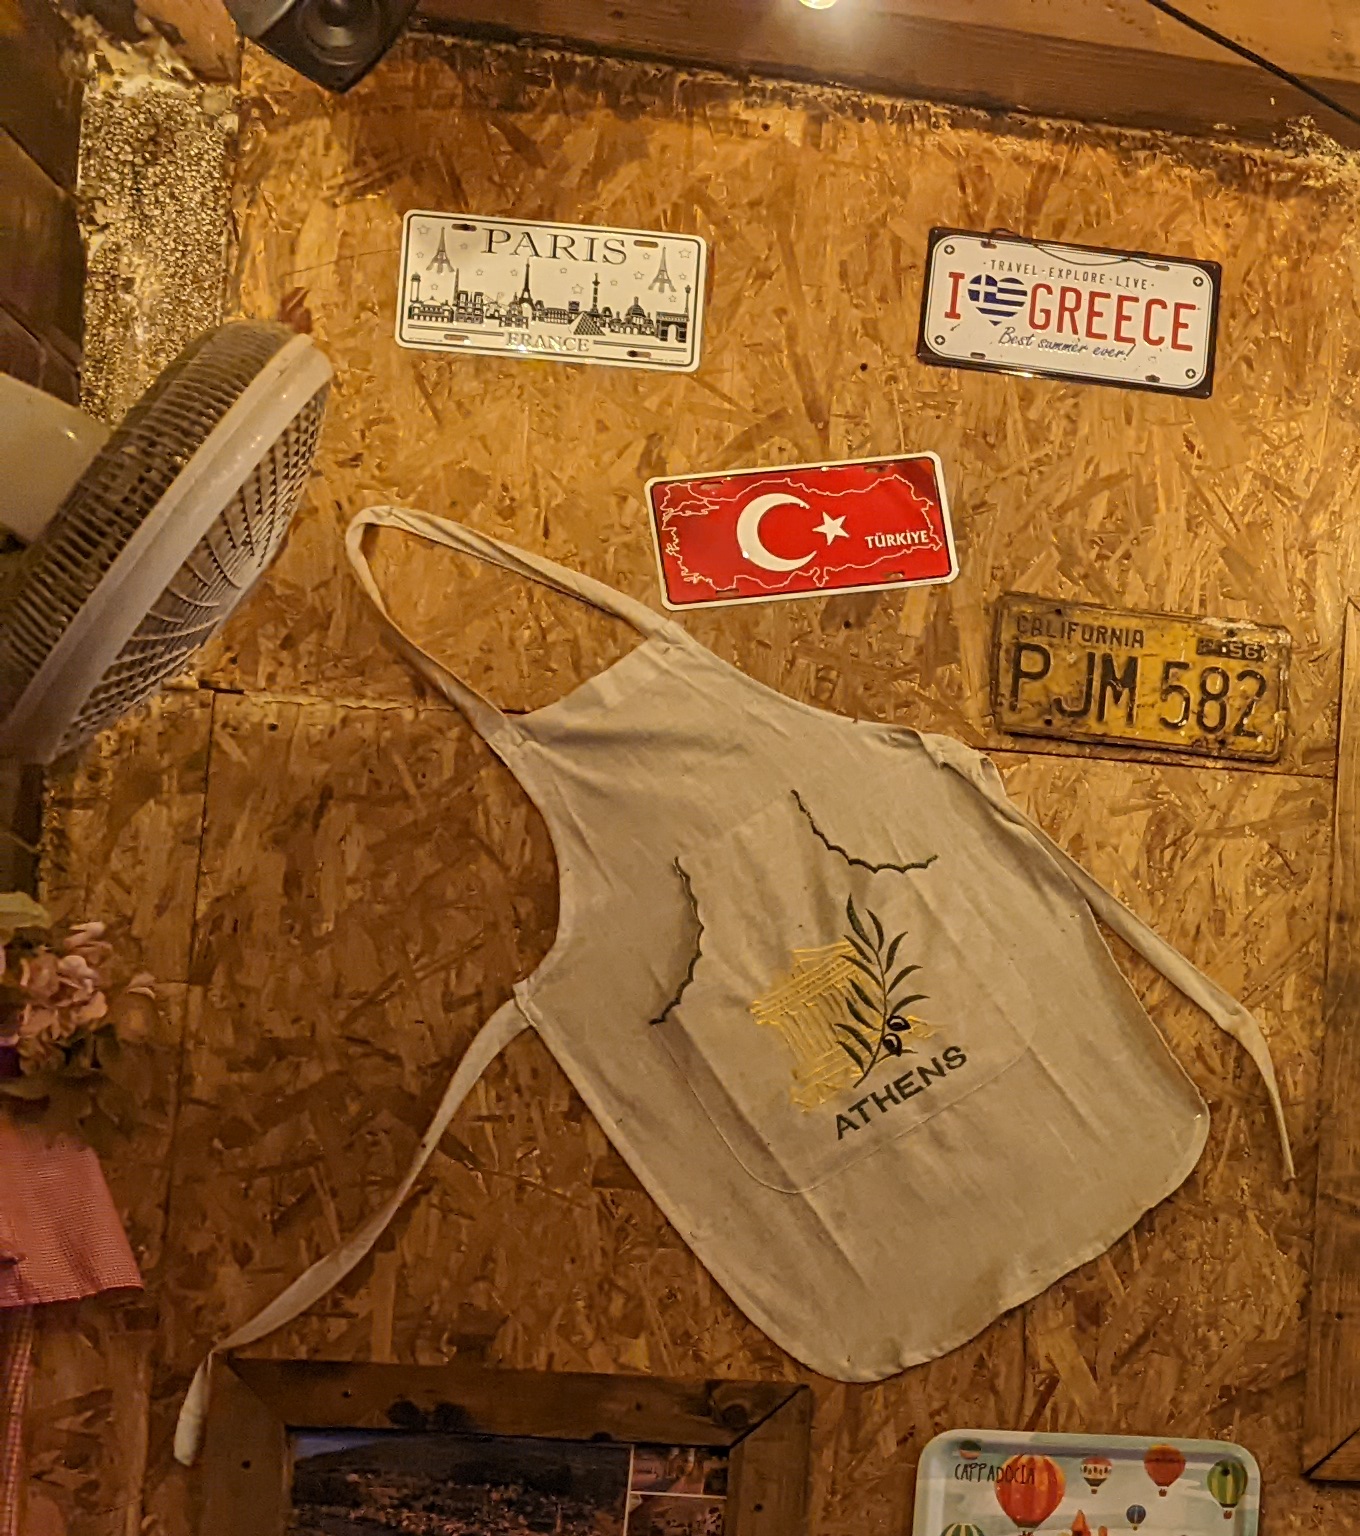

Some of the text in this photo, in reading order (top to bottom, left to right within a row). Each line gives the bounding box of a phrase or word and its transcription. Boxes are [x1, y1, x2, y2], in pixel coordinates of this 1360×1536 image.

[481, 228, 628, 265] PARIS
[990, 259, 1148, 290] TRAVEL EXPLORE LIVE
[944, 271, 1197, 352] I GREECE
[506, 330, 591, 353] FRANCE
[998, 326, 1138, 361] Best summer ever!
[865, 529, 930, 549] TÜRKİYE
[1015, 615, 1145, 649] CALIFORNIA
[1009, 641, 1268, 739] PJM 582
[834, 1044, 968, 1142] ATHENS
[954, 1461, 1036, 1485] CAPPADOCIA
